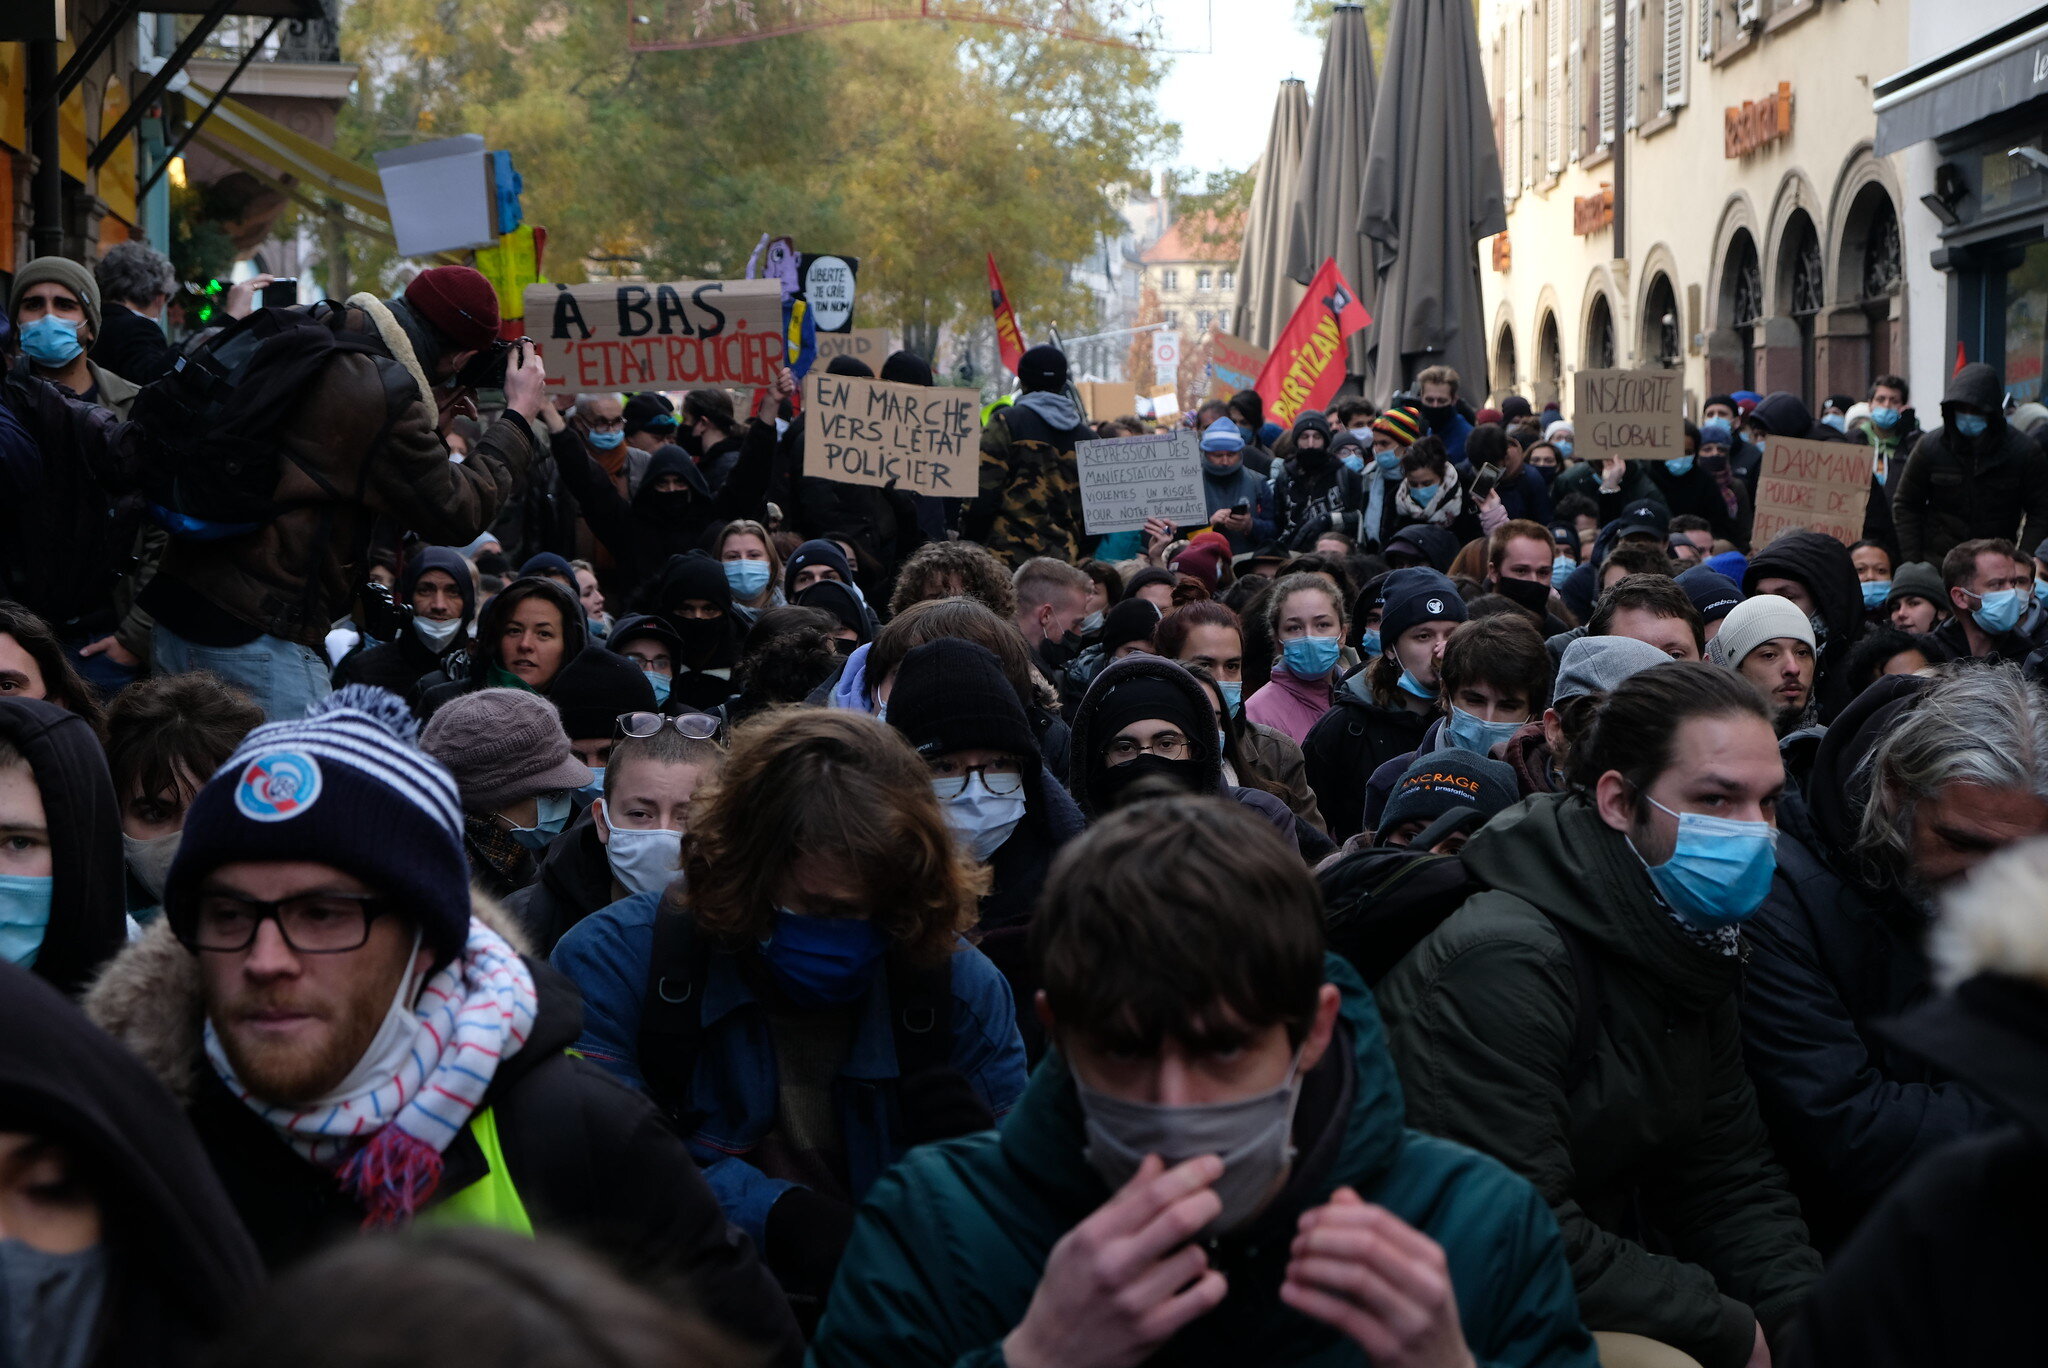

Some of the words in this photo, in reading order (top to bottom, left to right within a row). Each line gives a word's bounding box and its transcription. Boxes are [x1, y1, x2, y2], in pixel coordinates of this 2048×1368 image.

[813, 285, 824, 298] JE
[551, 283, 592, 339] À
[616, 283, 726, 340] BAS
[831, 300, 850, 312] NOM
[818, 336, 873, 358] OVID
[817, 376, 850, 410] EN
[867, 384, 973, 434] MARCHE
[821, 411, 883, 442] VERS
[894, 423, 969, 457] L'ÉTAT
[1592, 421, 1672, 451] GLOBALE
[1168, 440, 1190, 458] DES
[1085, 463, 1176, 485] MANIFESTATIONS
[1771, 444, 1873, 486] DARMANIN
[1086, 488, 1137, 503] VIOLENTES
[1146, 487, 1157, 498] UN
[1163, 484, 1195, 497] RISQUE
[1765, 481, 1817, 510] POUDRE
[1827, 490, 1851, 514] DE
[1086, 508, 1113, 521] POUR
[1120, 506, 1149, 519] NOTRE
[1434, 785, 1476, 801] prestations
